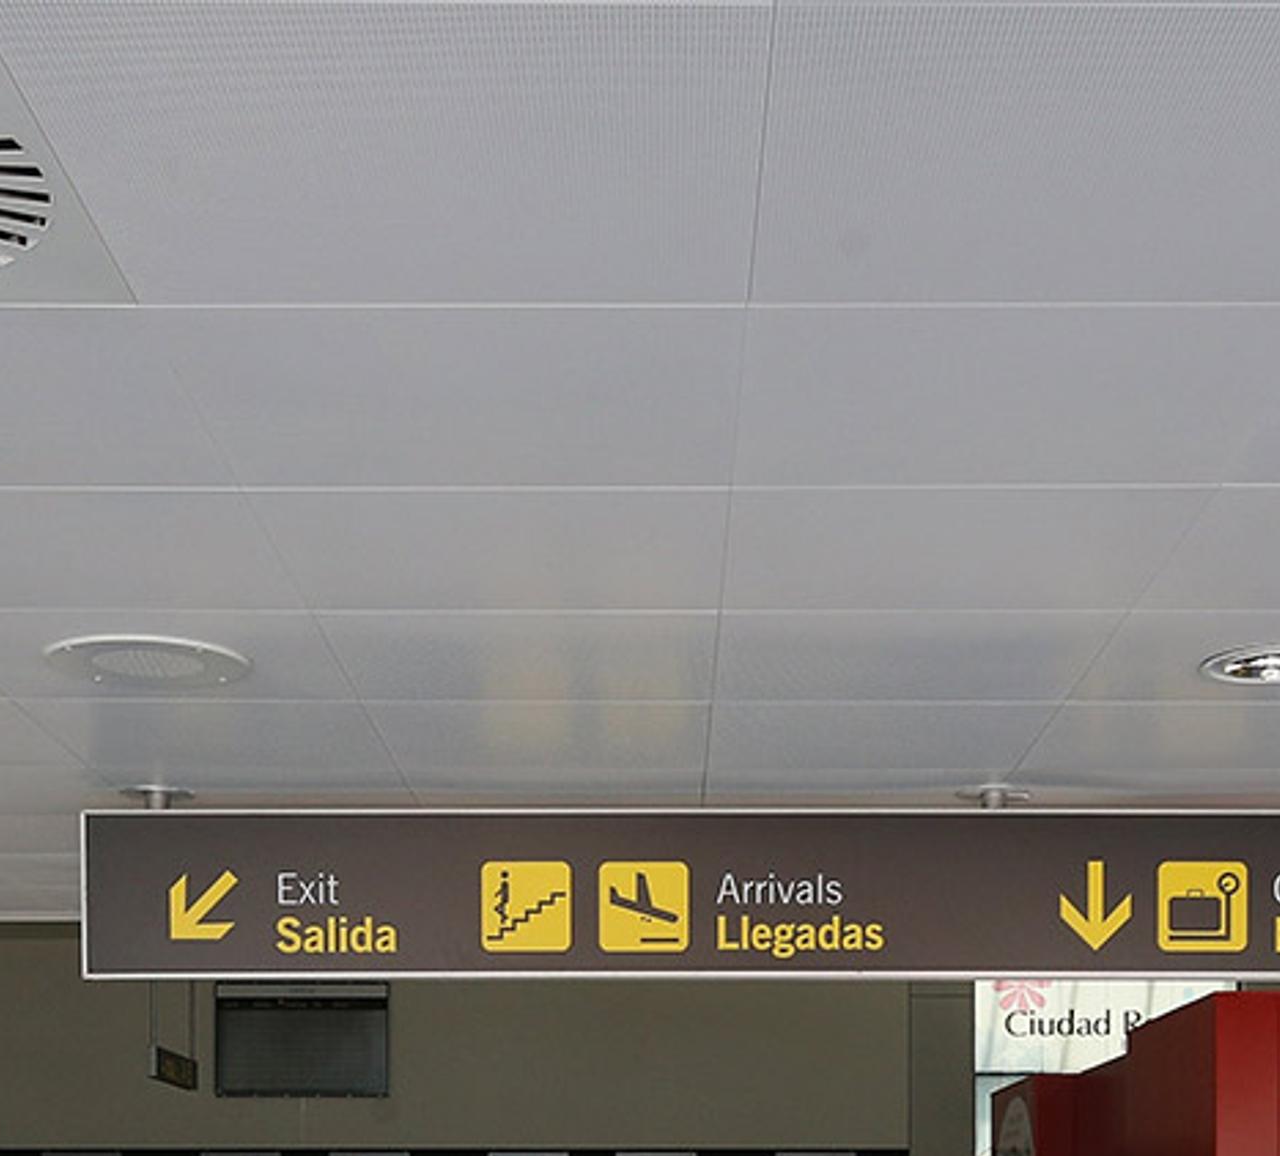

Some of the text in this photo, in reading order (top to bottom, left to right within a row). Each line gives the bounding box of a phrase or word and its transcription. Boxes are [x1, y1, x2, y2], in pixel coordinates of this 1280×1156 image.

[278, 872, 339, 904] Exit
[716, 872, 843, 904] Arrivals
[276, 916, 397, 953] Salida
[717, 915, 885, 959] Llegadas
[1004, 1009, 1111, 1037] Ciudad
